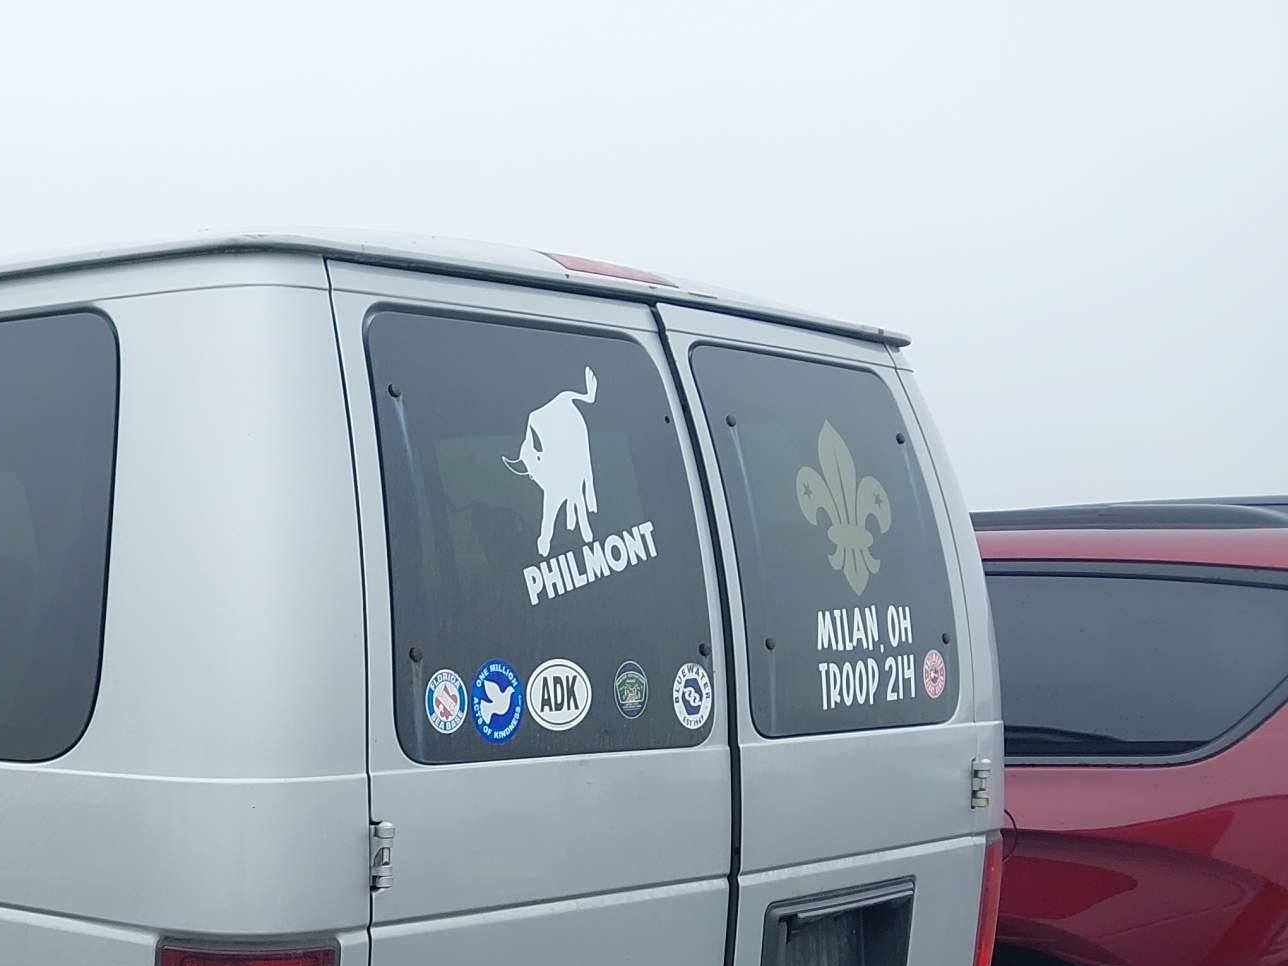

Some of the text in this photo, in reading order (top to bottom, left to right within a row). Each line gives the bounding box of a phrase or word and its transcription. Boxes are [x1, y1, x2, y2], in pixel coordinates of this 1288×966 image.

[523, 521, 657, 605] PHILMONT
[817, 605, 913, 653] MILAN, OH
[430, 672, 460, 691] FLORIDA
[476, 663, 518, 688] ONE MILLION
[540, 675, 580, 713] ADK
[818, 658, 879, 710] TROOP
[884, 654, 916, 701] 214
[431, 710, 464, 730] SEA BASE
[473, 697, 521, 739] ACTS OF KINDNESS
